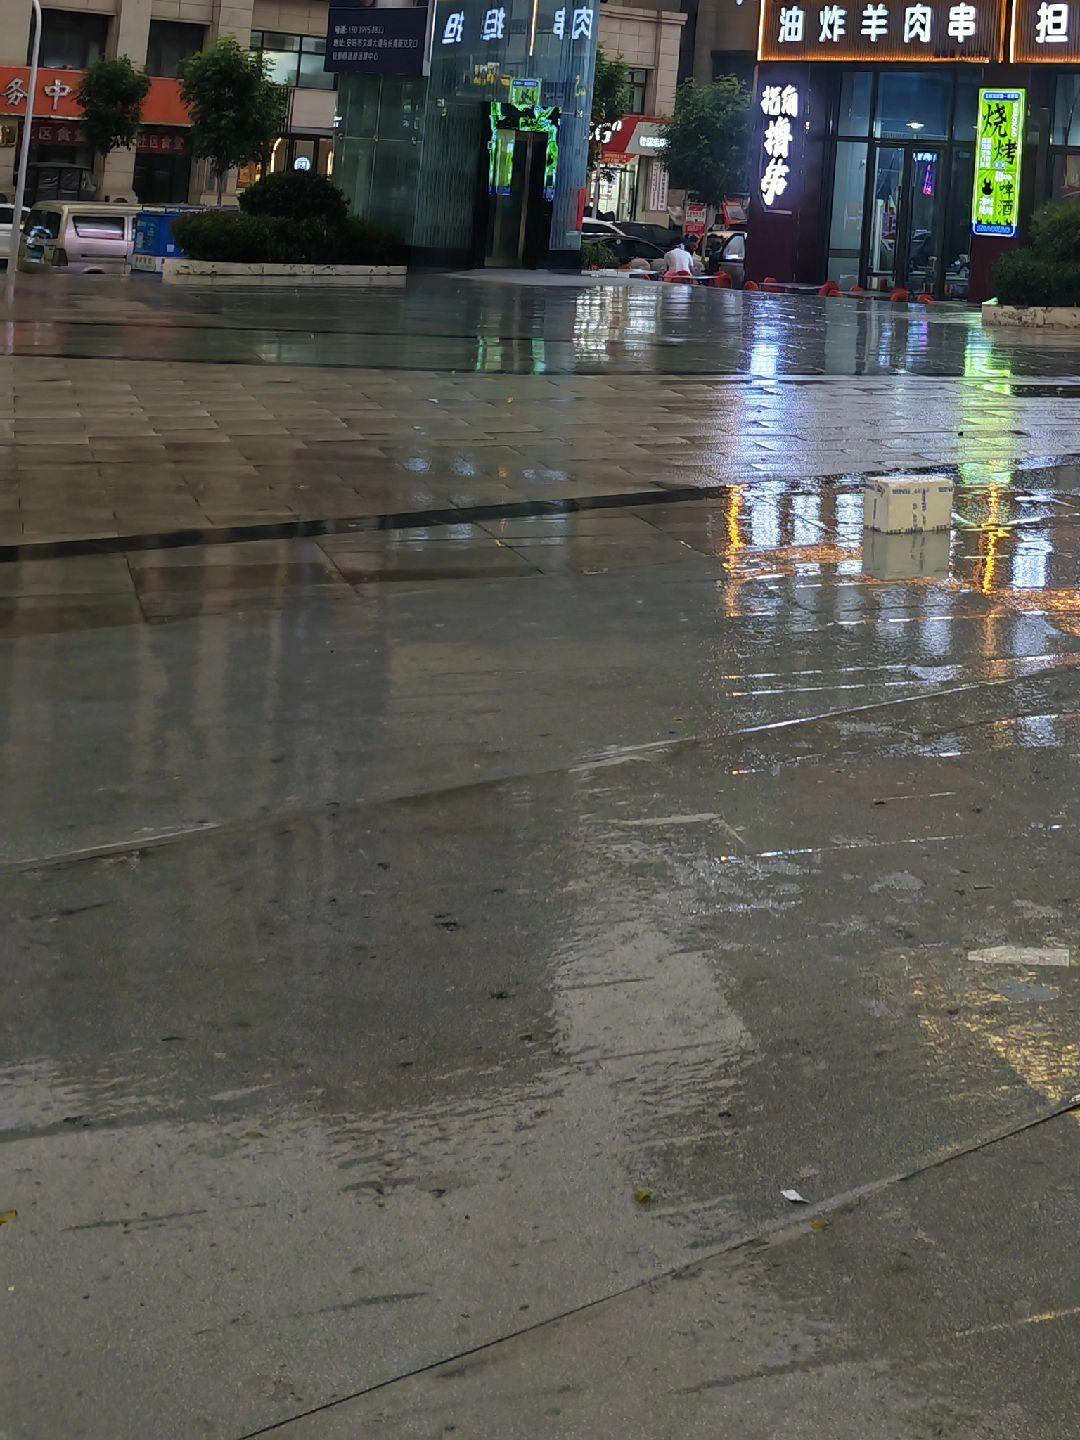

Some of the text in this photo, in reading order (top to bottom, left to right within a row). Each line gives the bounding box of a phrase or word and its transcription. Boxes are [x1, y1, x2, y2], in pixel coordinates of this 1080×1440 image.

[777, 2, 977, 43] 油炸羊肉串
[981, 102, 1018, 166] 烧烤
[998, 181, 1014, 216] 啤酒
